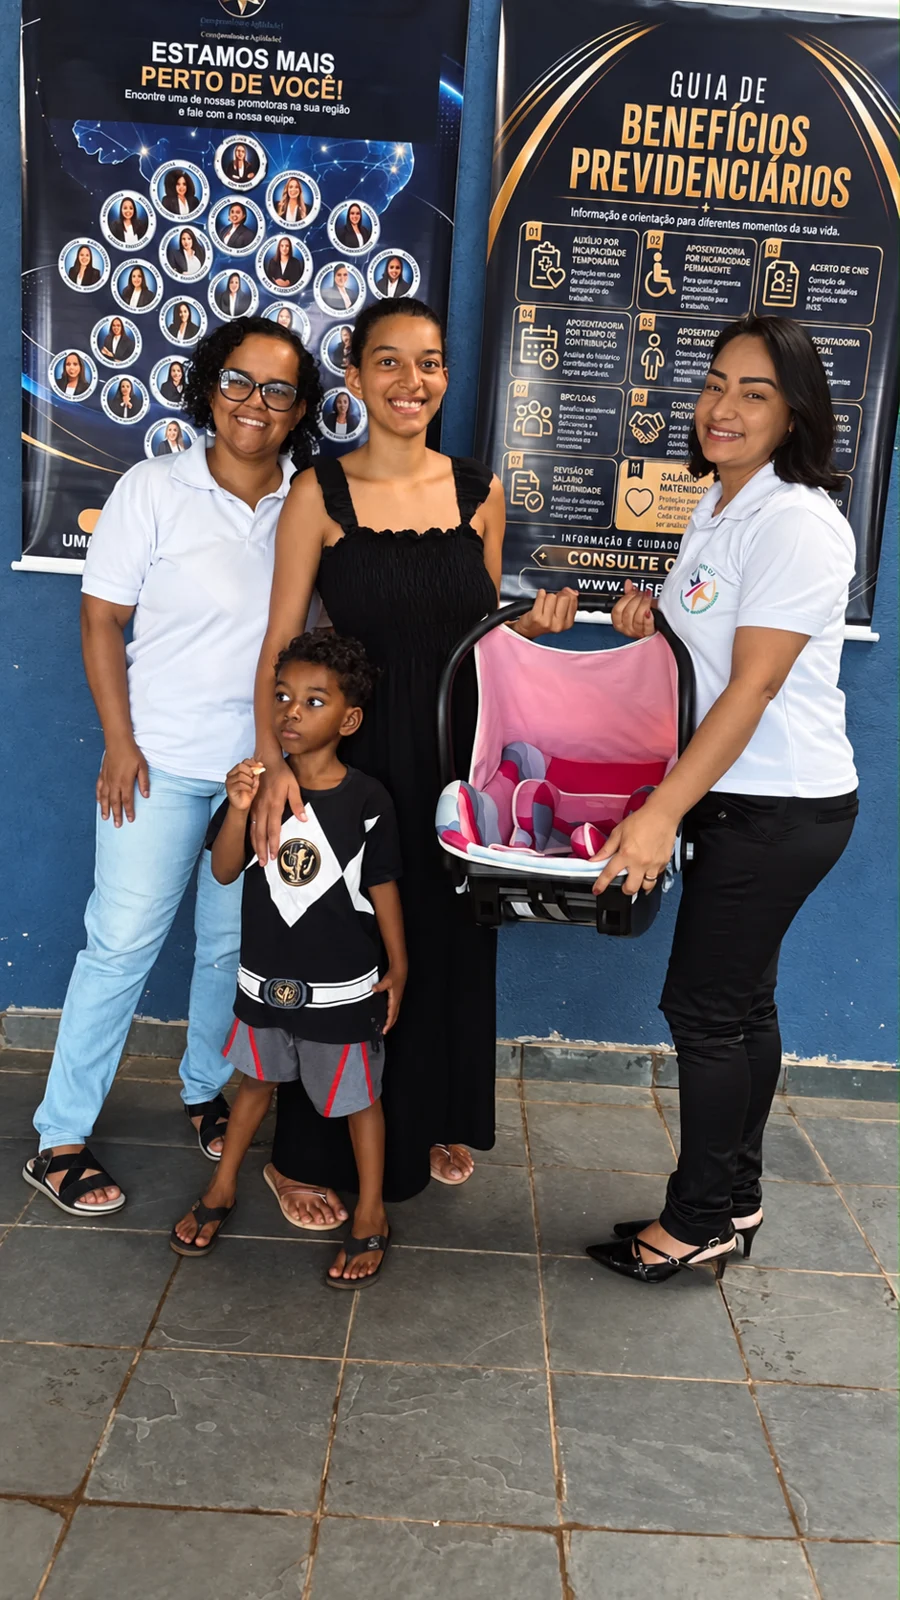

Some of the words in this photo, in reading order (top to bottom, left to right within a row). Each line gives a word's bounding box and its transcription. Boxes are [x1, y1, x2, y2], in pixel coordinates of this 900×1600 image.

[152, 41, 268, 69] ESTAMOS
[276, 50, 335, 74] MAIS
[141, 66, 223, 93] PERTO
[231, 73, 262, 95] DE
[270, 74, 343, 100] VOCÊ!
[670, 70, 727, 101] GUIA
[740, 76, 767, 104] DE
[125, 89, 166, 101] Encontre
[168, 95, 188, 103] uma
[190, 93, 201, 104] de
[204, 96, 235, 106] nossas
[238, 97, 288, 111] promotoras
[290, 102, 301, 111] na
[303, 103, 320, 113] sua
[322, 103, 350, 117] região
[178, 108, 184, 117] e
[187, 107, 203, 118] fale
[206, 110, 225, 120] com
[227, 112, 233, 120] a
[235, 112, 262, 122] nossa
[265, 113, 296, 126] equipe.
[621, 102, 810, 157] BENEFÍCIOS
[569, 147, 852, 209] PREVIDENCIÁRIOS
[571, 207, 620, 222] Informação
[621, 212, 628, 221] e
[629, 212, 675, 226] orientação
[677, 217, 696, 227] para
[698, 217, 741, 230] diferentes
[743, 220, 787, 233] momentos
[789, 222, 801, 233] da
[802, 226, 818, 234] sua
[819, 224, 840, 237] vida.
[529, 227, 538, 236] 01
[650, 235, 660, 245] 02
[572, 246, 626, 257] INCAPACIDADE
[686, 245, 745, 256] APOSENTADORIA
[767, 244, 778, 254] 03
[572, 256, 619, 266] TEMPORÁRIA
[685, 254, 699, 262] POR
[810, 264, 839, 273] ACERTO
[840, 266, 850, 274] DE
[852, 266, 869, 275] CNIS
[522, 309, 532, 318] 04
[566, 319, 624, 330] APOSENTADORIA
[582, 330, 605, 338] TEMPO
[693, 339, 715, 347] IDADE
[516, 384, 526, 394] 07
[560, 393, 596, 403] BPC/LOAS
[634, 393, 644, 402] 08
[511, 456, 521, 465] 07
[552, 484, 602, 495] MATERNIDADE
[561, 534, 622, 547] INFORMAÇÃO
[627, 536, 632, 547] É
[638, 538, 678, 550] CUIDADO
[567, 550, 658, 571] CONSULTE
